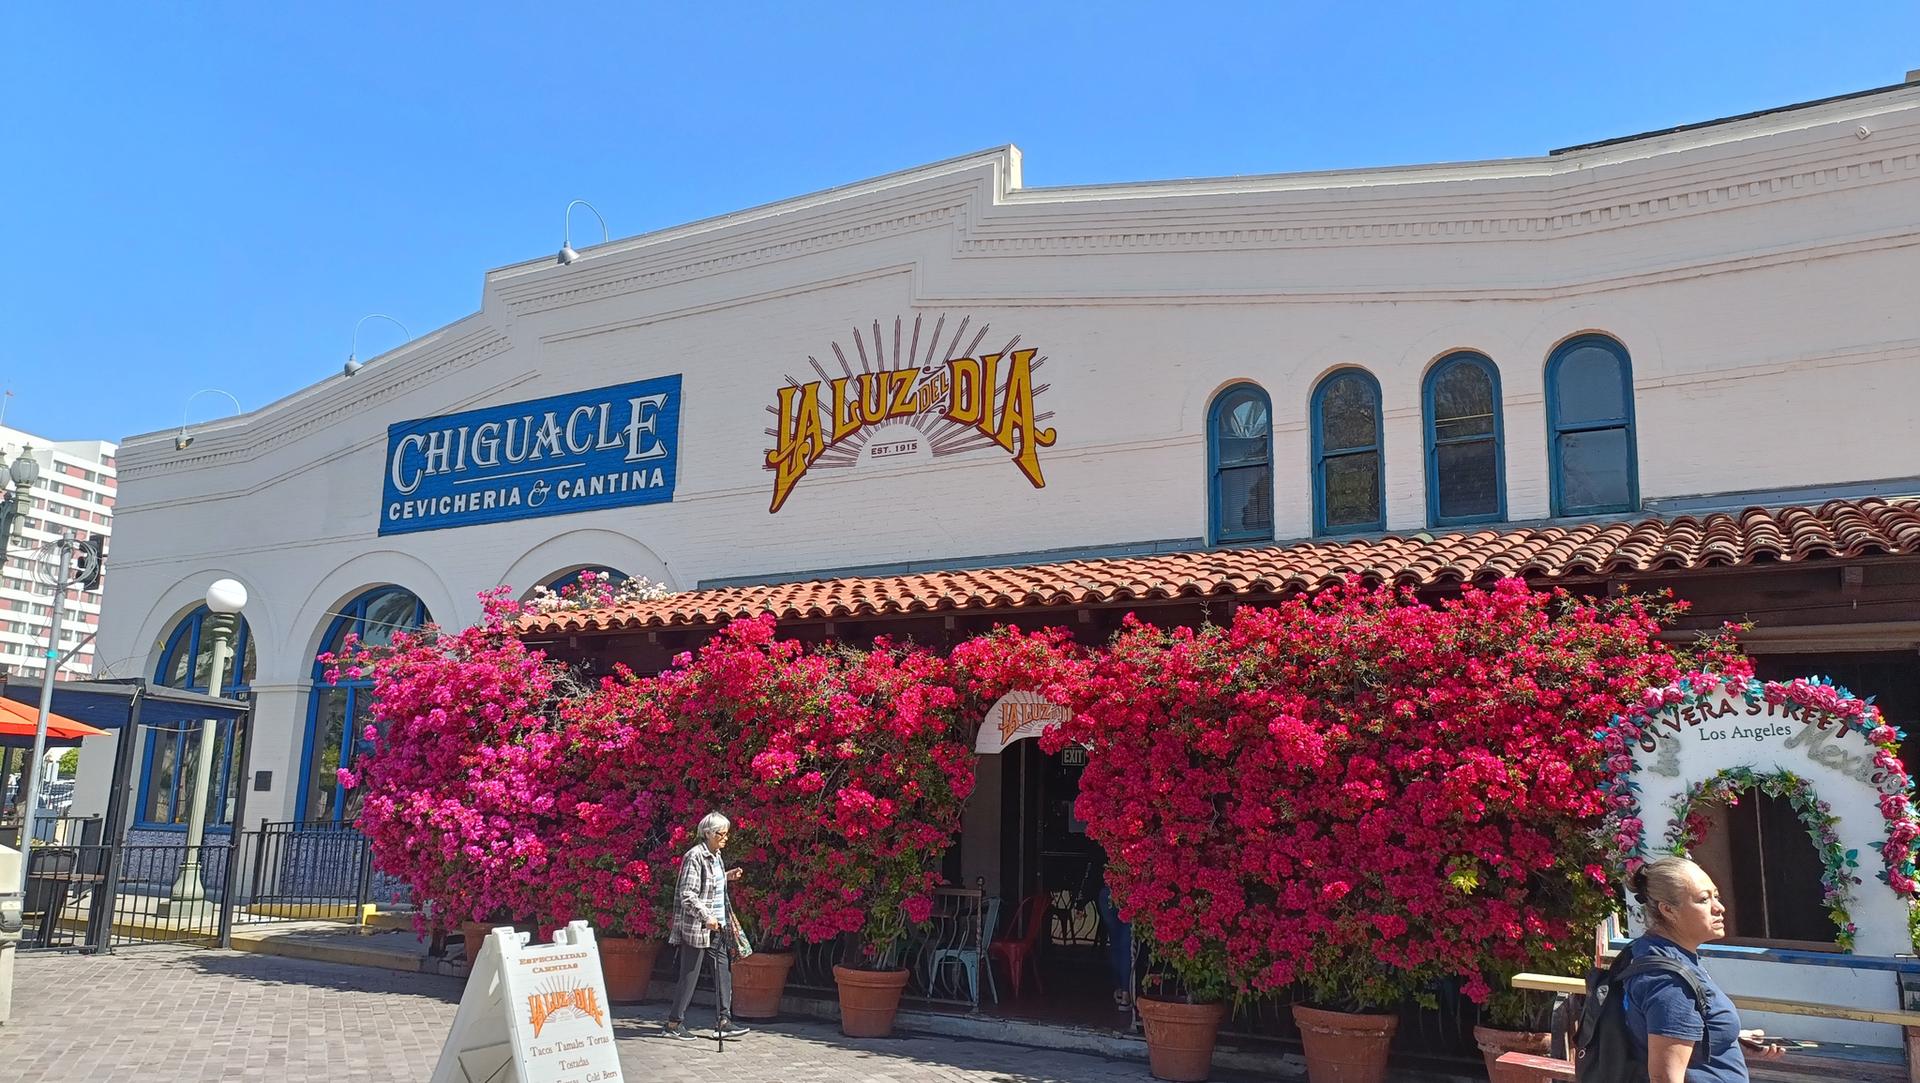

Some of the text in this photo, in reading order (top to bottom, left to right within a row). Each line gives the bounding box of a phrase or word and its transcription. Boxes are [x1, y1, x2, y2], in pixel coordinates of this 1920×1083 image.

[766, 348, 1057, 514] LA LUZ DEL DIA
[391, 393, 669, 496] CHIGUACLE
[871, 443, 917, 455] EST. 1915
[389, 467, 665, 521] CEVICHERIA & CANTINA
[1021, 703, 1051, 726] LUZ
[1699, 723, 1792, 742] Los Angeles
[1063, 750, 1083, 763] EXIT
[530, 1046, 553, 1057] Tacos
